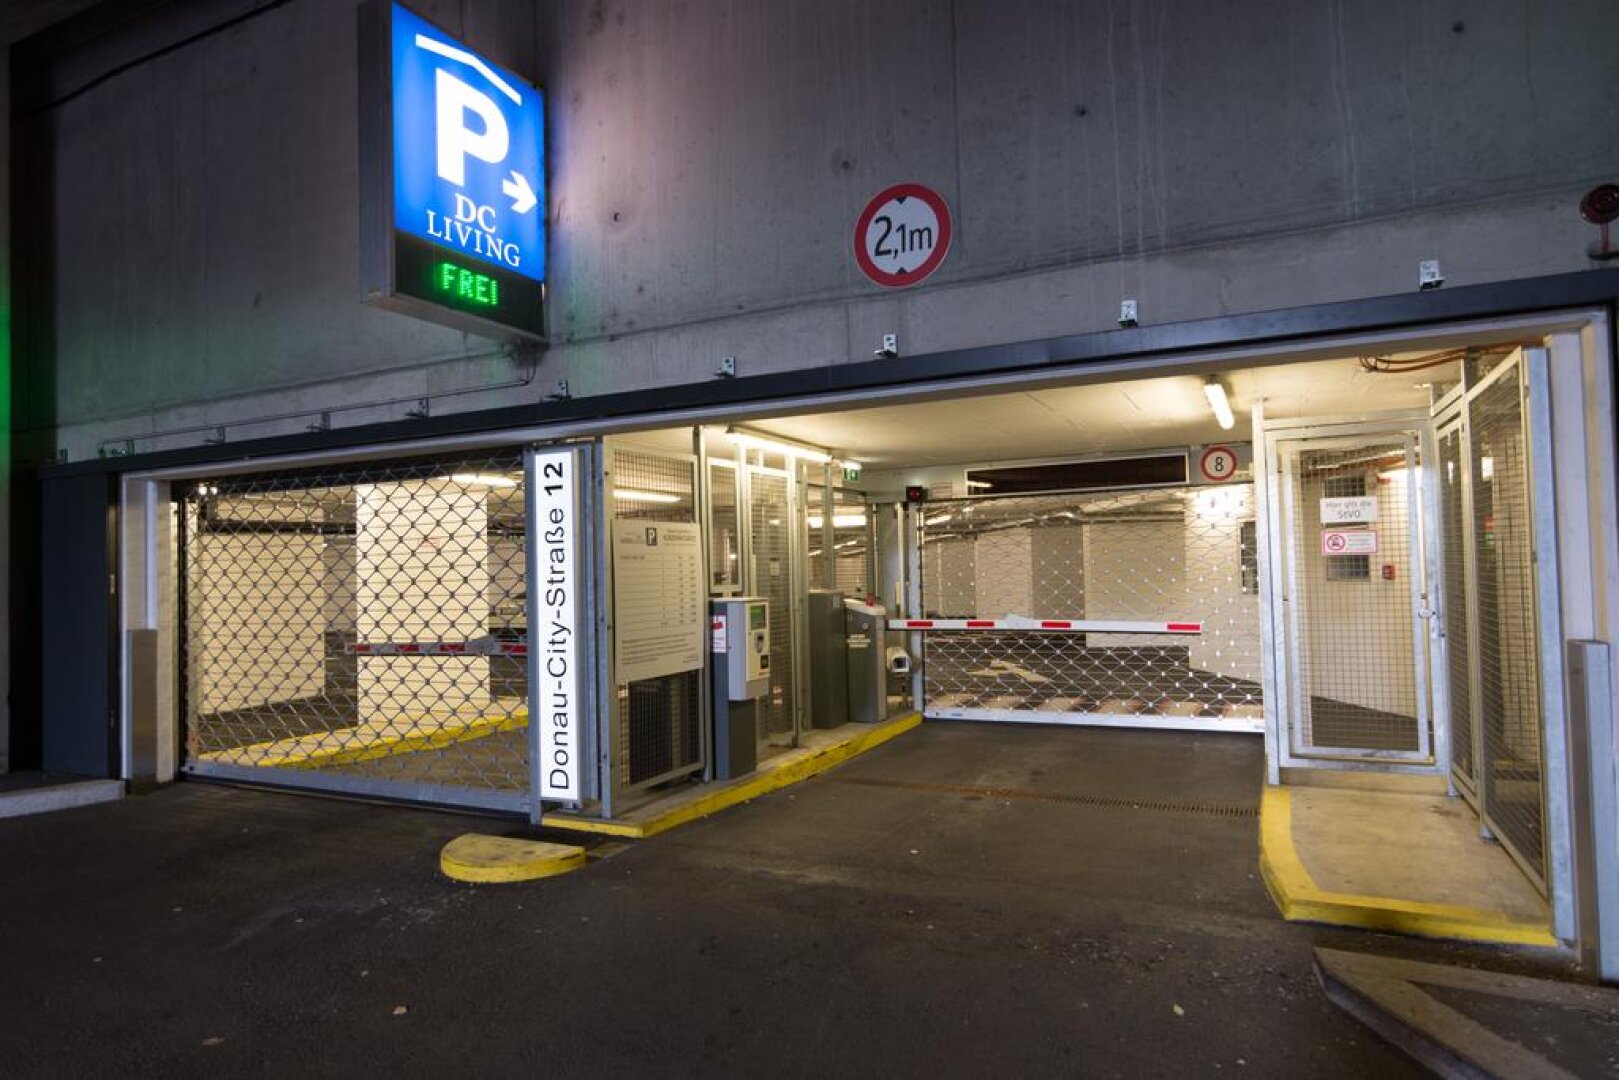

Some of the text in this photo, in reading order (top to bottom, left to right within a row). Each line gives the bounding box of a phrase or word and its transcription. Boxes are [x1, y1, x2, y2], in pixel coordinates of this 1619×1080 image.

[436, 67, 510, 187] P
[455, 193, 497, 234] DC
[427, 210, 521, 267] LIVING
[874, 214, 932, 260] 2,1m
[440, 263, 499, 305] FREI
[1214, 456, 1224, 472] 8
[543, 462, 572, 790] Donau-City-Straße 12
